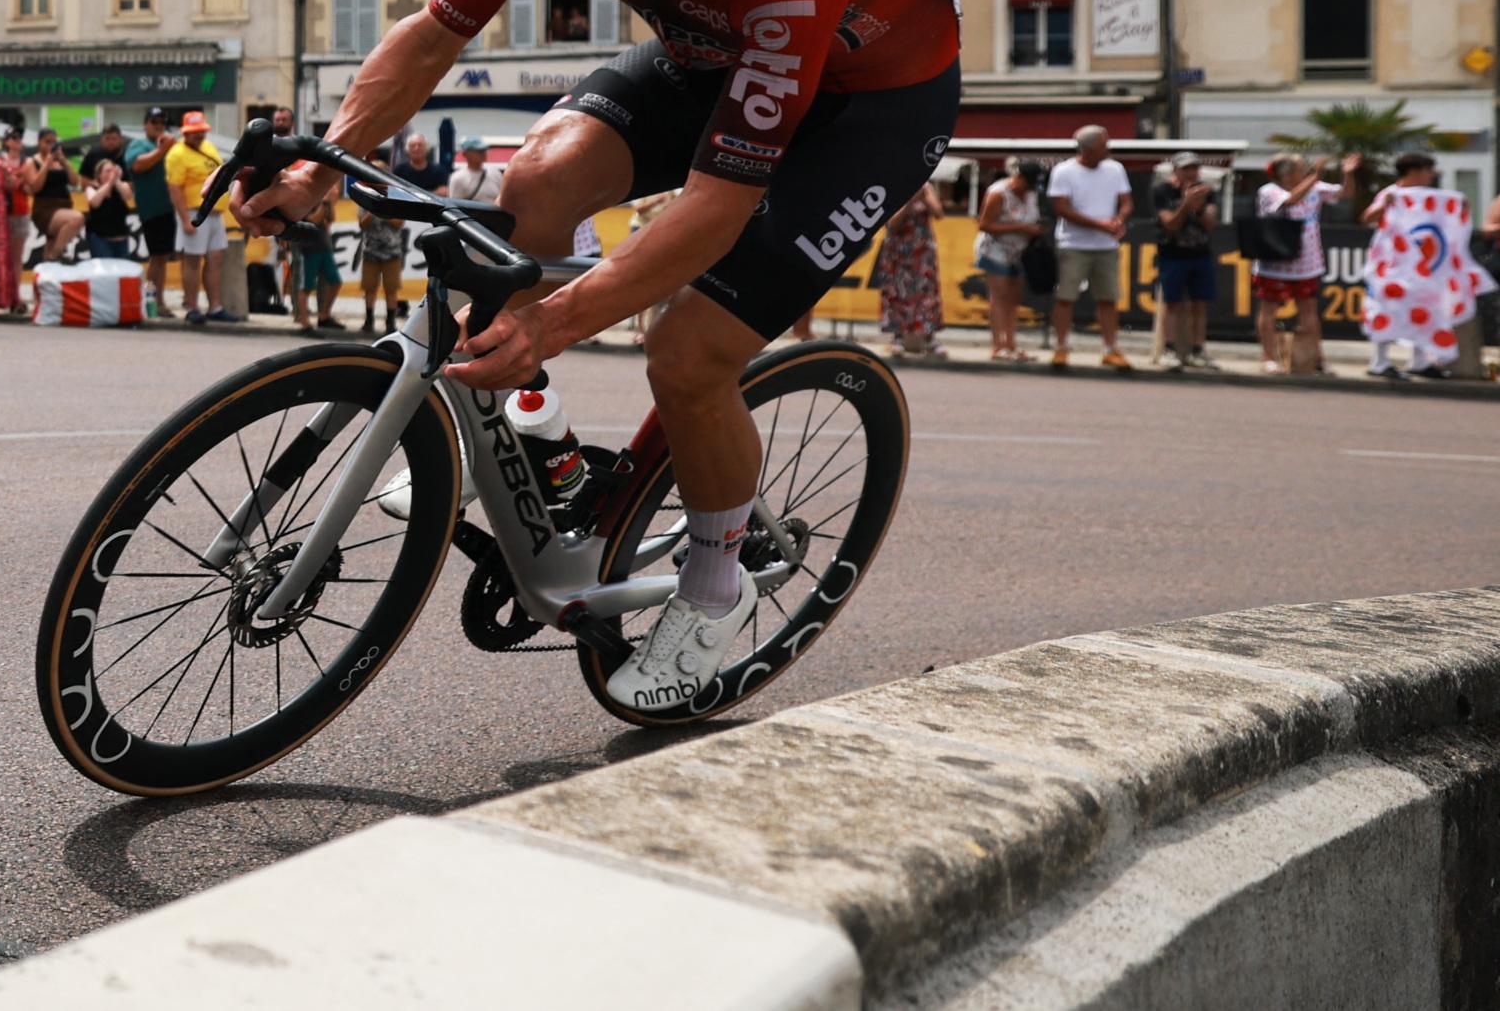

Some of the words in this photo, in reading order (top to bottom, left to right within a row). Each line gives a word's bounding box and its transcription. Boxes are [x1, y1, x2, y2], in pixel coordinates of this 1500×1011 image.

[157, 75, 191, 90] JUST
[455, 69, 492, 88] AXA
[470, 388, 552, 558] ORBEA
